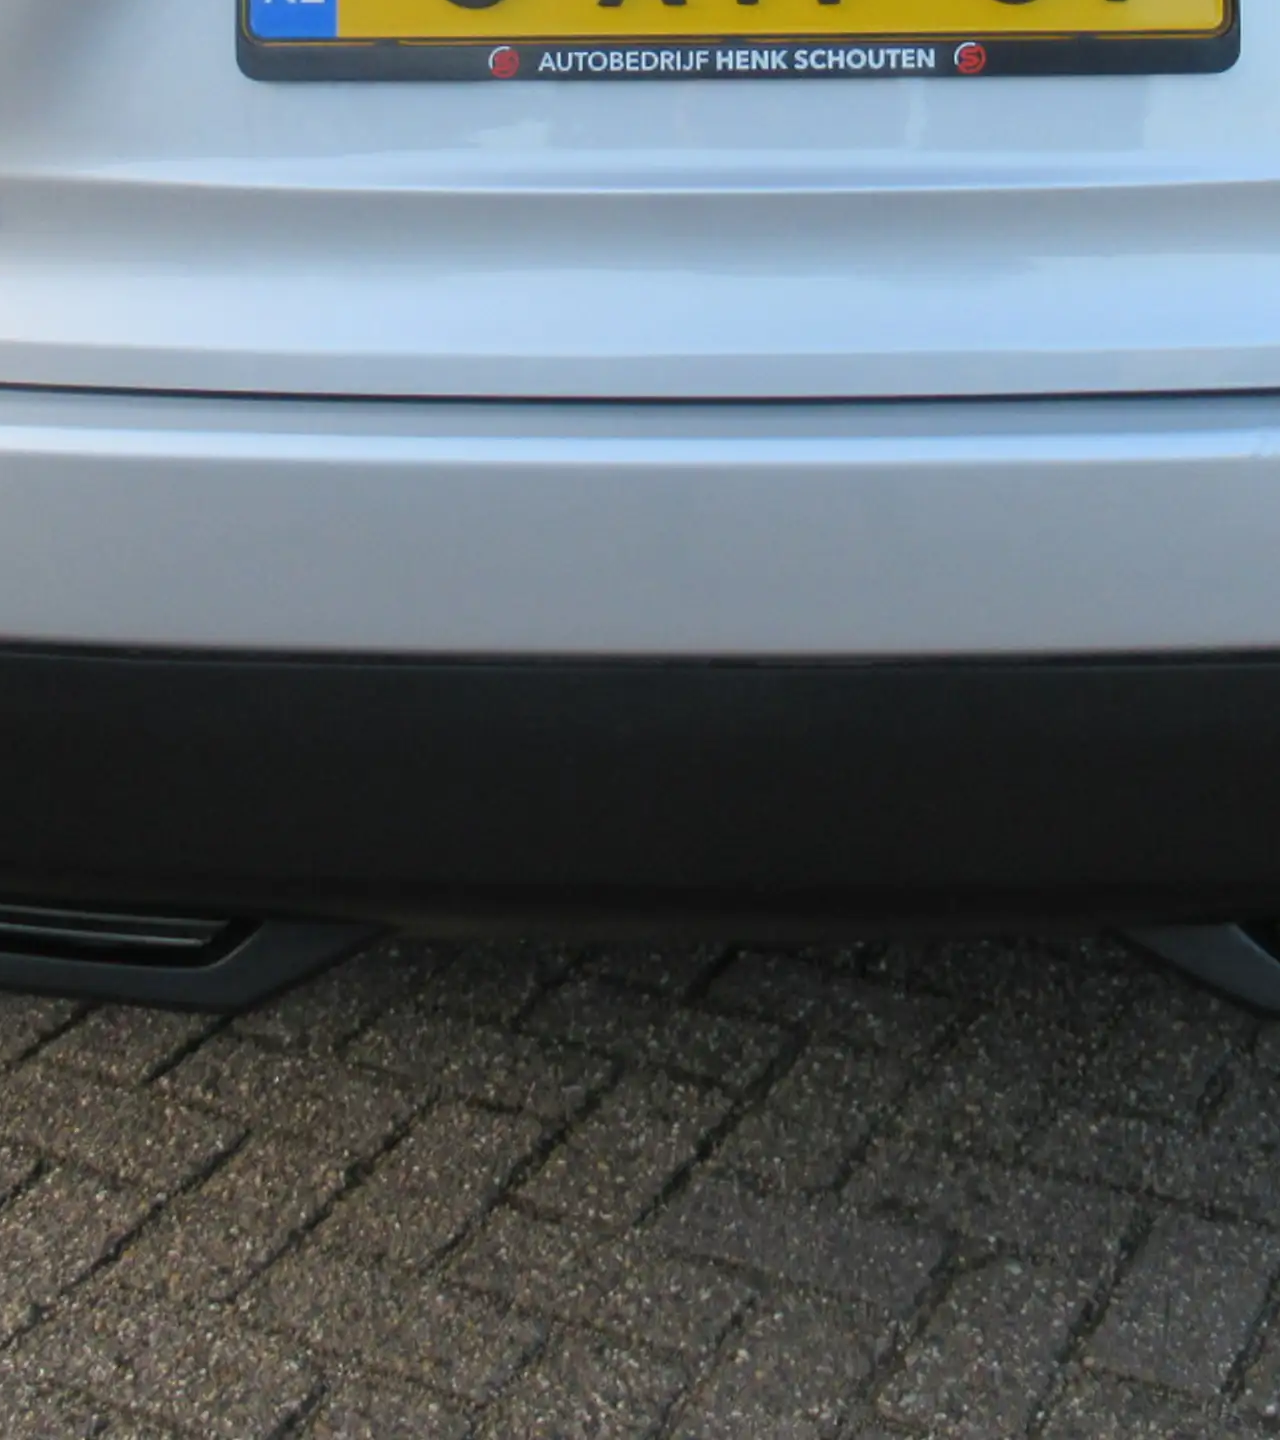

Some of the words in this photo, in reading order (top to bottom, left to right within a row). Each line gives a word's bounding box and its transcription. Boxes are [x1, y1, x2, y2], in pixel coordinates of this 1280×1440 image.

[537, 49, 710, 72] AUTOBEDRIJF
[715, 49, 790, 71] HENK
[794, 47, 936, 71] SCHOUTEN
